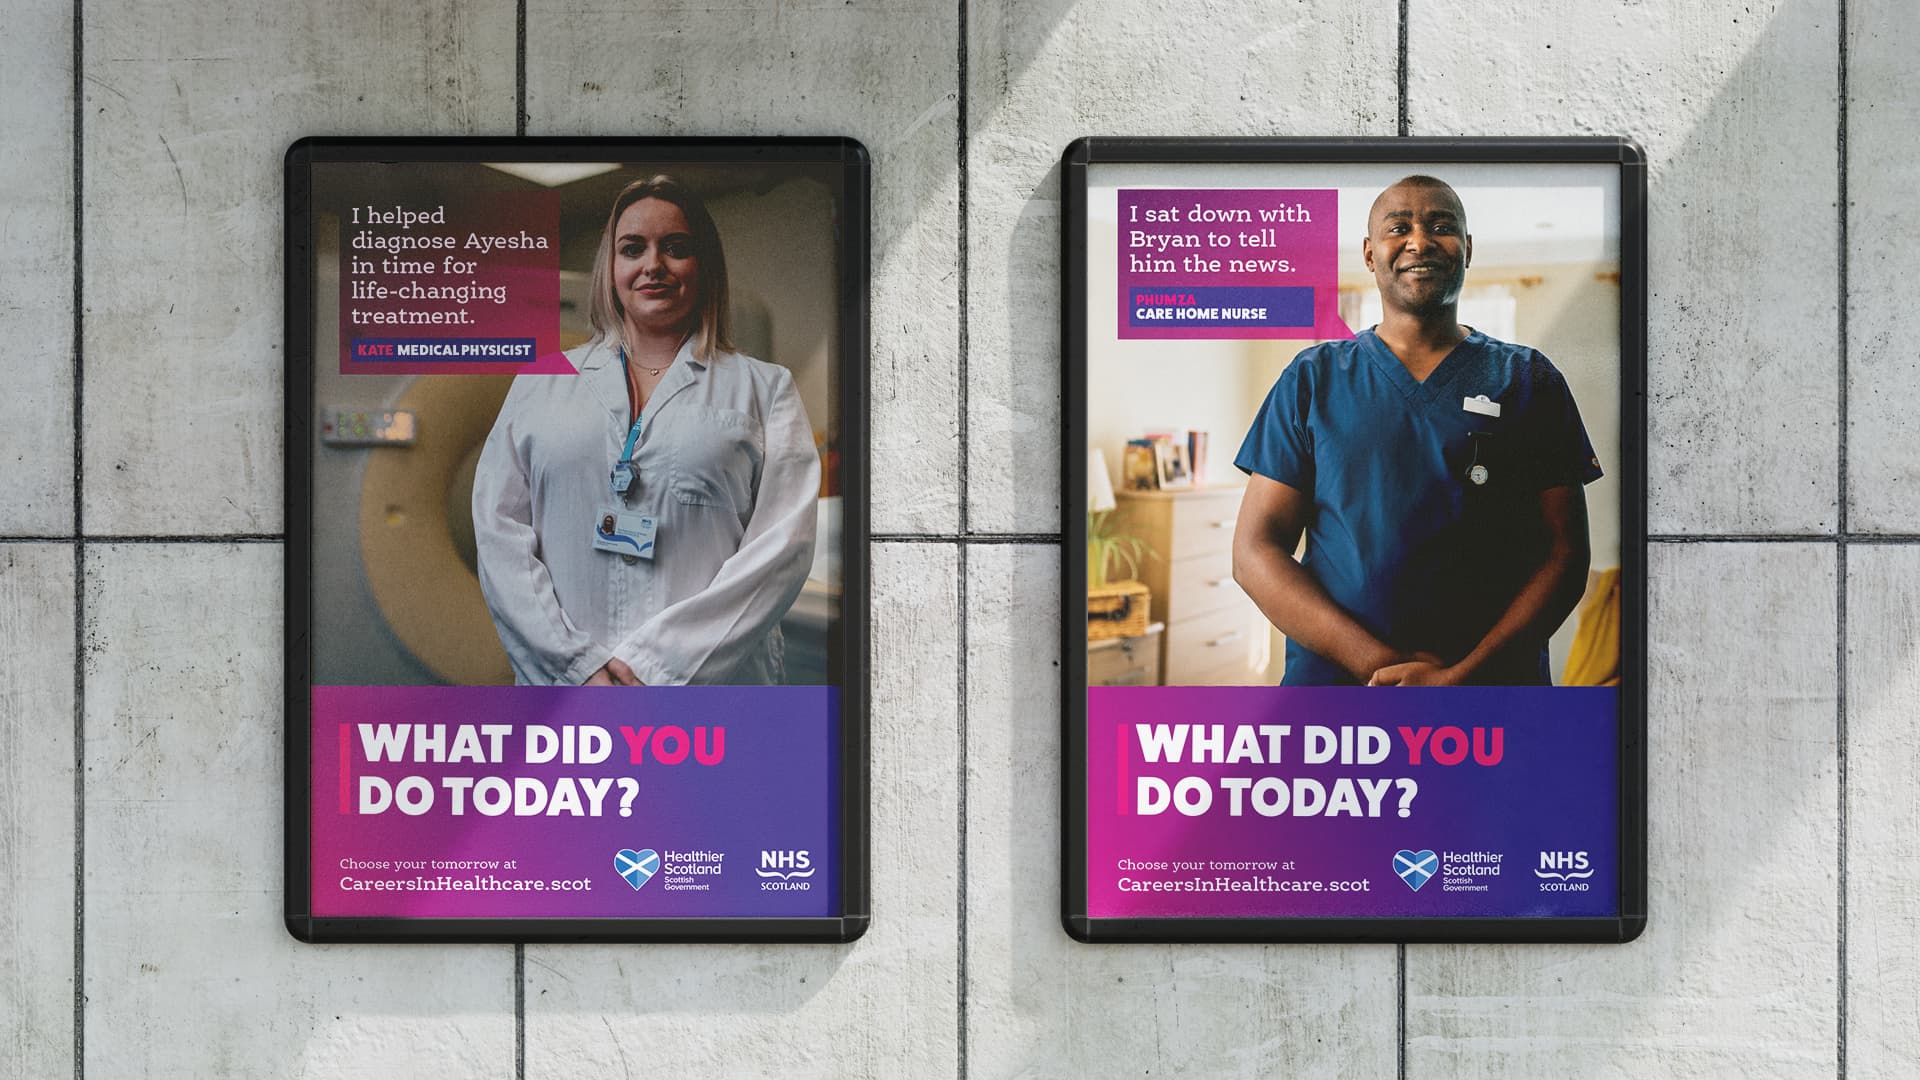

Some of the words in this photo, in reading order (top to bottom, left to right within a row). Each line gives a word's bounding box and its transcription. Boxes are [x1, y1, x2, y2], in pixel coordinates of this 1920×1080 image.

[351, 207, 360, 224] I
[368, 205, 445, 228] helped
[1129, 206, 1138, 222] I
[1145, 206, 1180, 222] sat
[1188, 204, 1252, 222] down
[1259, 204, 1312, 222] with
[352, 231, 456, 252] diagnose
[464, 231, 548, 253] Ayesha
[1130, 231, 1201, 252] Bryan
[1208, 231, 1232, 248] to
[1239, 229, 1276, 248] tell
[351, 256, 375, 274] in
[382, 256, 435, 274] time
[443, 256, 477, 274] for
[1130, 254, 1176, 272] him
[1183, 254, 1221, 272] the
[1229, 259, 1296, 273] news.
[351, 281, 507, 303] life-changing
[1136, 294, 1196, 306] PHUMZA
[351, 308, 475, 324] treatment.
[1136, 308, 1173, 319] CARE
[1176, 308, 1219, 319] HOME
[1221, 308, 1267, 319] NURSE
[358, 345, 393, 356] KATE
[397, 345, 460, 356] MEDICAL
[461, 345, 531, 356] PHYSICIST
[358, 724, 513, 763] WHAT
[526, 725, 613, 764] DID
[620, 727, 725, 764] YOU
[1136, 724, 1291, 763] WHAT
[1303, 726, 1391, 765] DID
[1398, 727, 1504, 766] YOU
[359, 776, 435, 815] DO
[442, 777, 640, 817] TODAY?
[1136, 776, 1213, 816] DO
[1220, 777, 1418, 818] TODAY?
[340, 858, 390, 870] Choose
[394, 860, 426, 872] your
[431, 859, 499, 870] tomorrow
[503, 859, 517, 870] at
[664, 851, 724, 862] Healthier
[761, 851, 811, 868] NHS
[1443, 852, 1503, 863] Healthier
[1540, 852, 1590, 869] NHS
[664, 863, 722, 875] Scotland
[1117, 859, 1168, 871] Choose
[1173, 861, 1205, 873] your
[1209, 860, 1277, 871] tomorrow
[1281, 860, 1295, 871] at
[1443, 864, 1501, 876] Scotland
[340, 875, 591, 892] CareersInHealthcare.scot
[664, 883, 710, 891] Government
[760, 882, 810, 890] SCOTLAND
[1117, 876, 1370, 893] CareersInHealthcare.scot
[1443, 884, 1488, 892] Government
[1540, 883, 1589, 891] SCOTLAND
